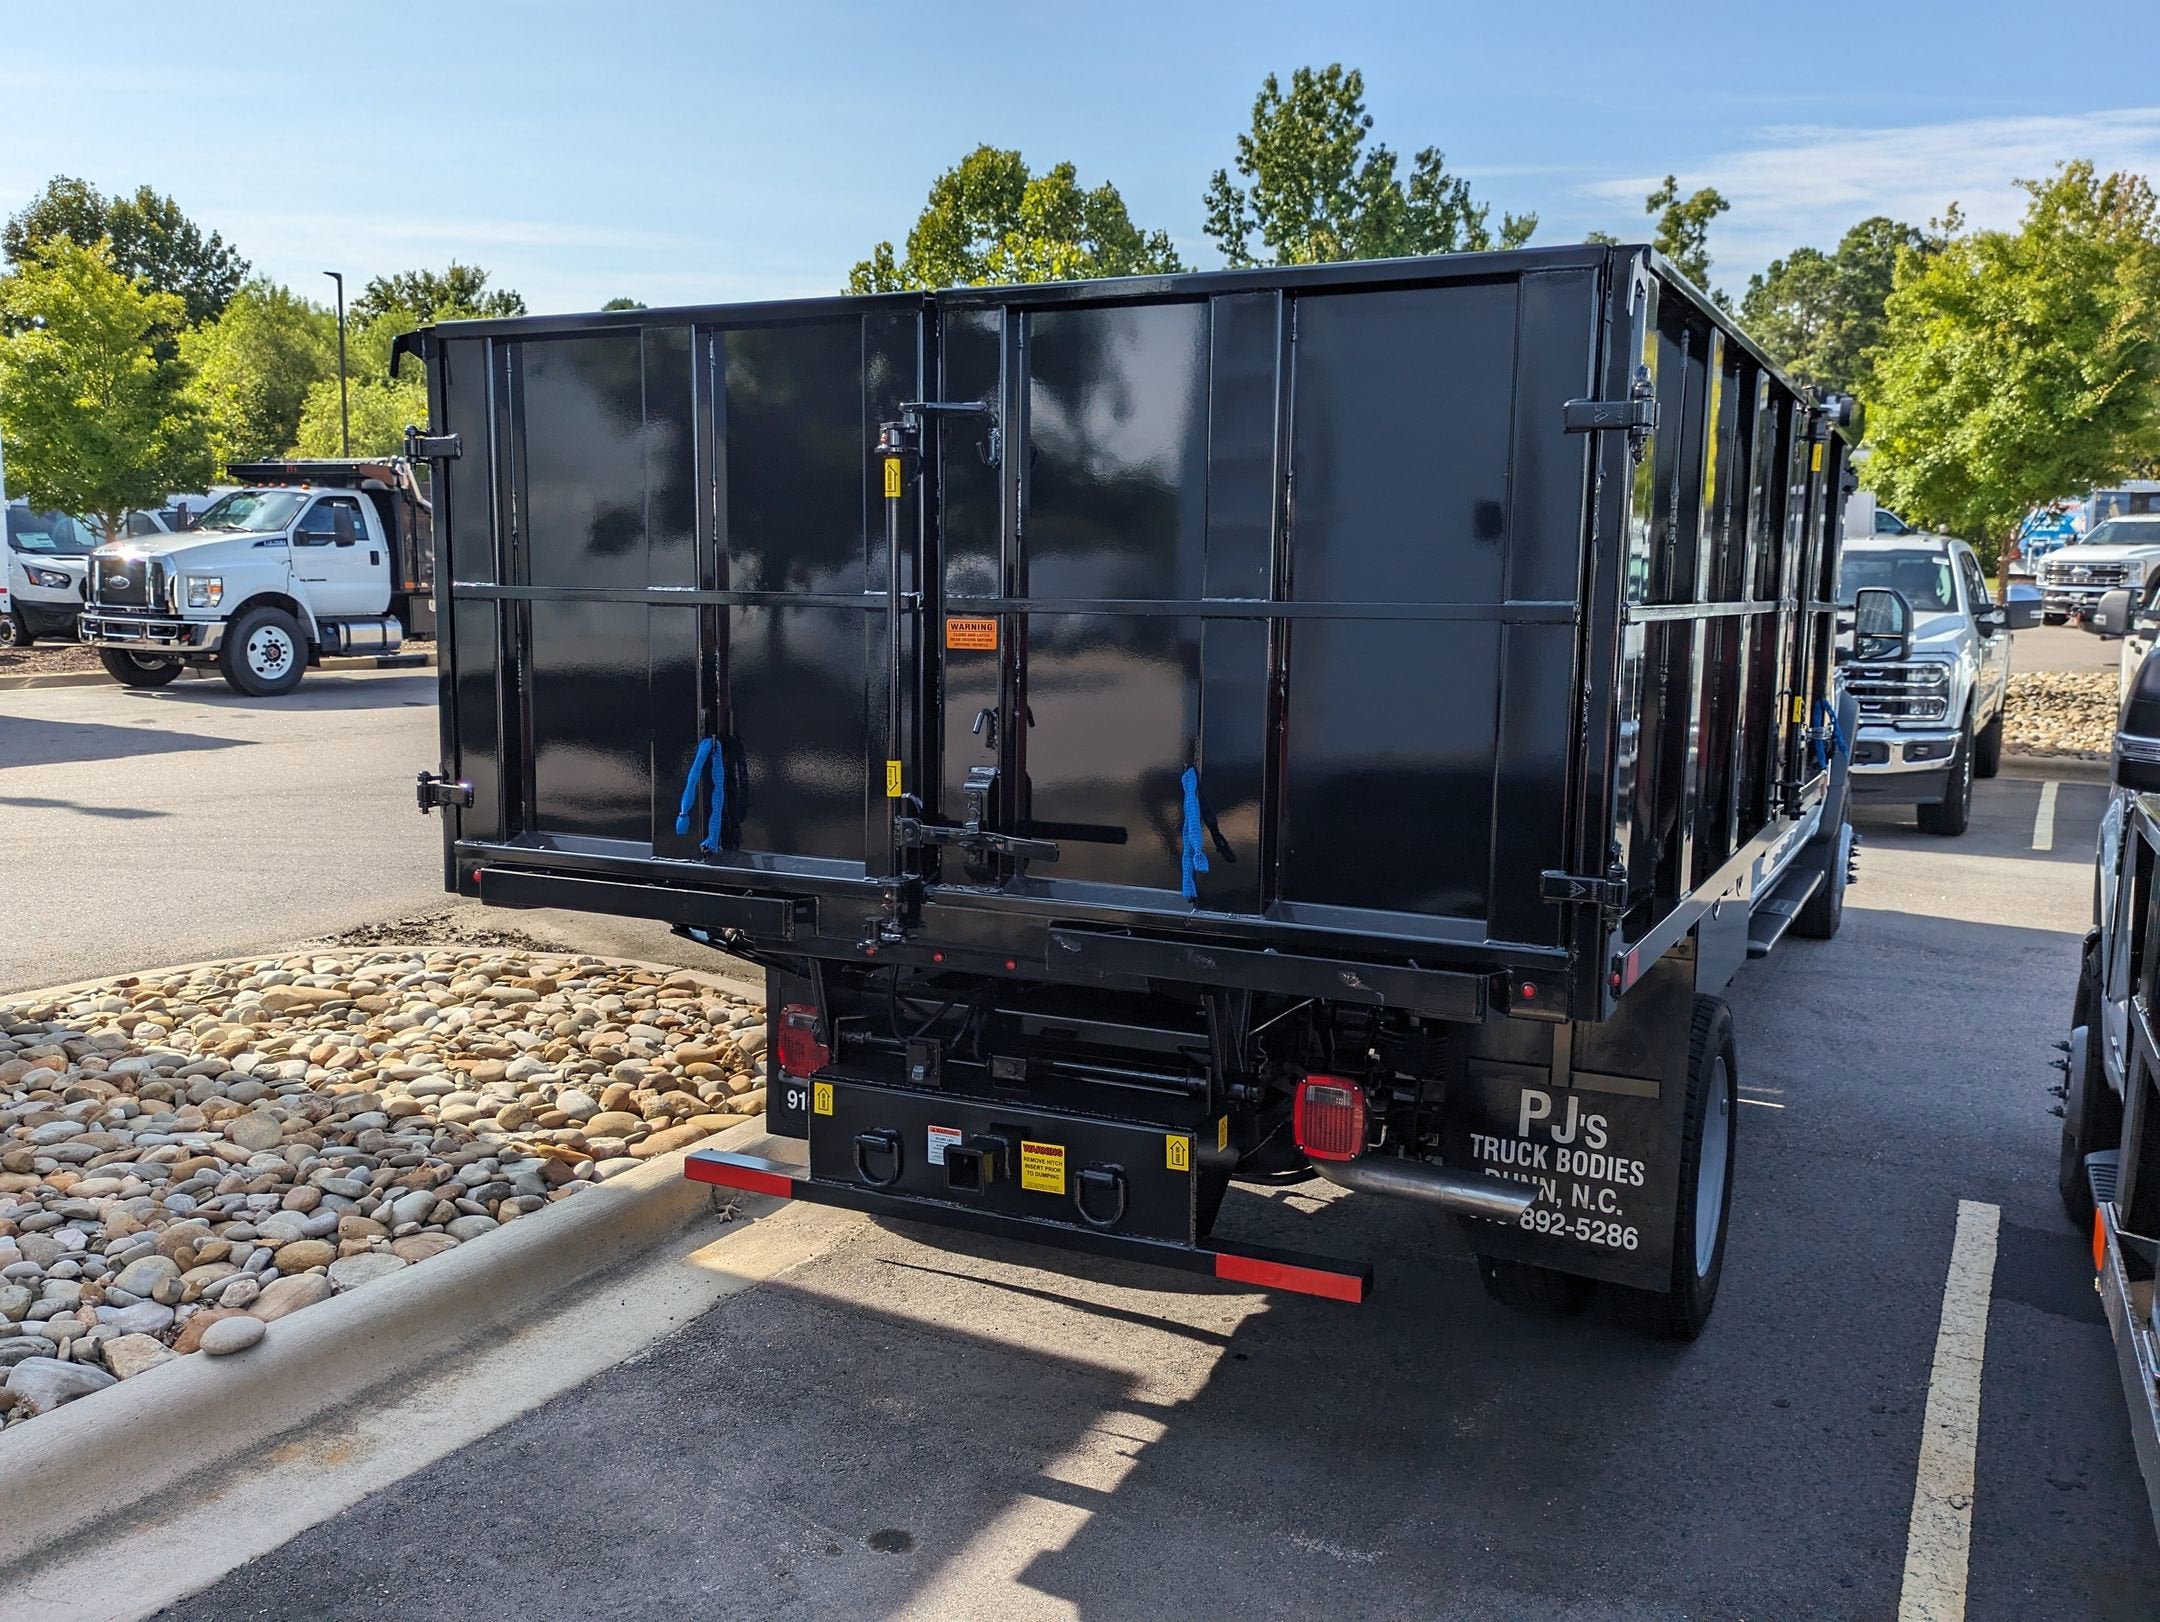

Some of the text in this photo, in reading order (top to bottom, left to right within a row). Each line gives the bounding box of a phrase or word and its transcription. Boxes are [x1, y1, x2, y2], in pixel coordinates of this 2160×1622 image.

[951, 623, 993, 631] WARNING
[1023, 1143, 1064, 1158] WARNING
[1023, 1156, 1063, 1167] REMOVE HITCH
[1470, 1133, 1645, 1187] TRUCK BODIES
[1024, 1163, 1044, 1171] INSERT
[1035, 1171, 1060, 1180] DUMPING
[1571, 1183, 1623, 1216] N.C.
[1520, 1207, 1639, 1251] 892-5286
